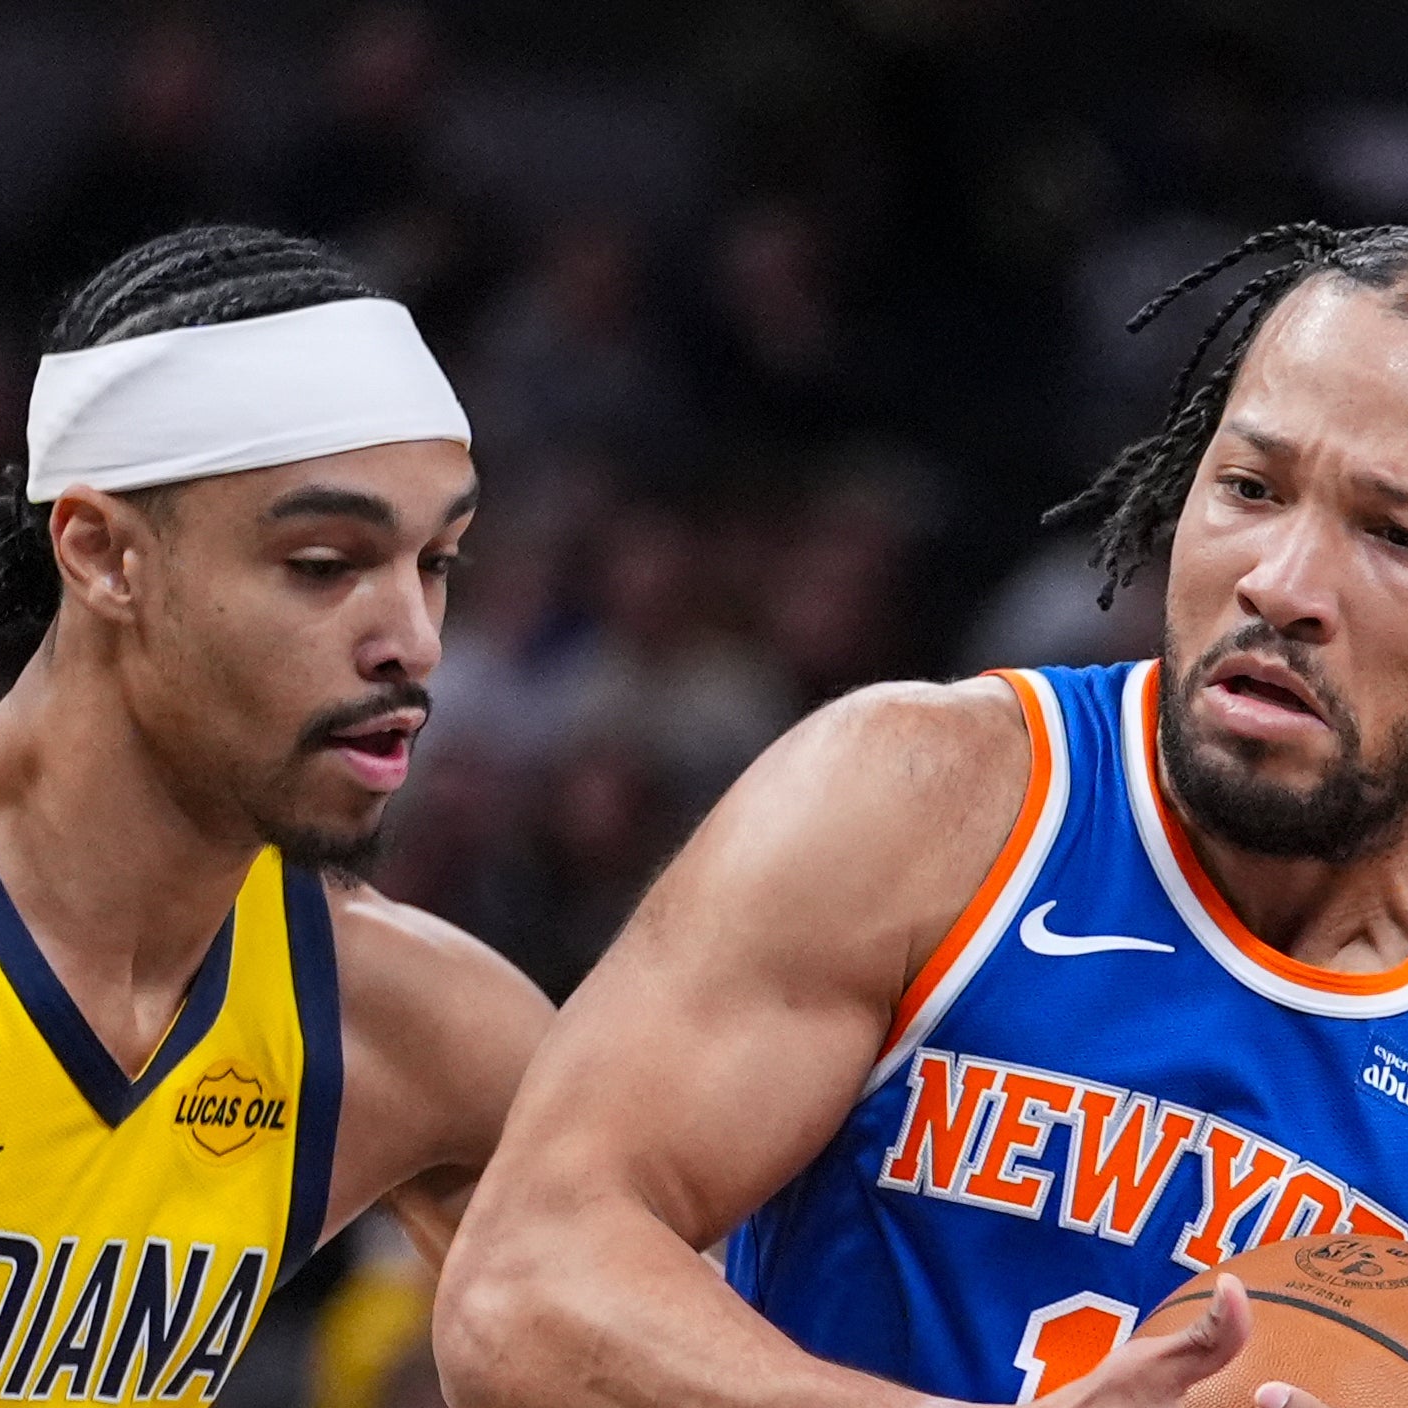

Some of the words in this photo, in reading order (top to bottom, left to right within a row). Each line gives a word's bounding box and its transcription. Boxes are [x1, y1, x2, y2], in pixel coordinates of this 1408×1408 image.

[174, 1094, 242, 1129] LUCAS
[243, 1098, 286, 1130] OIL
[877, 1046, 1209, 1247] NEW
